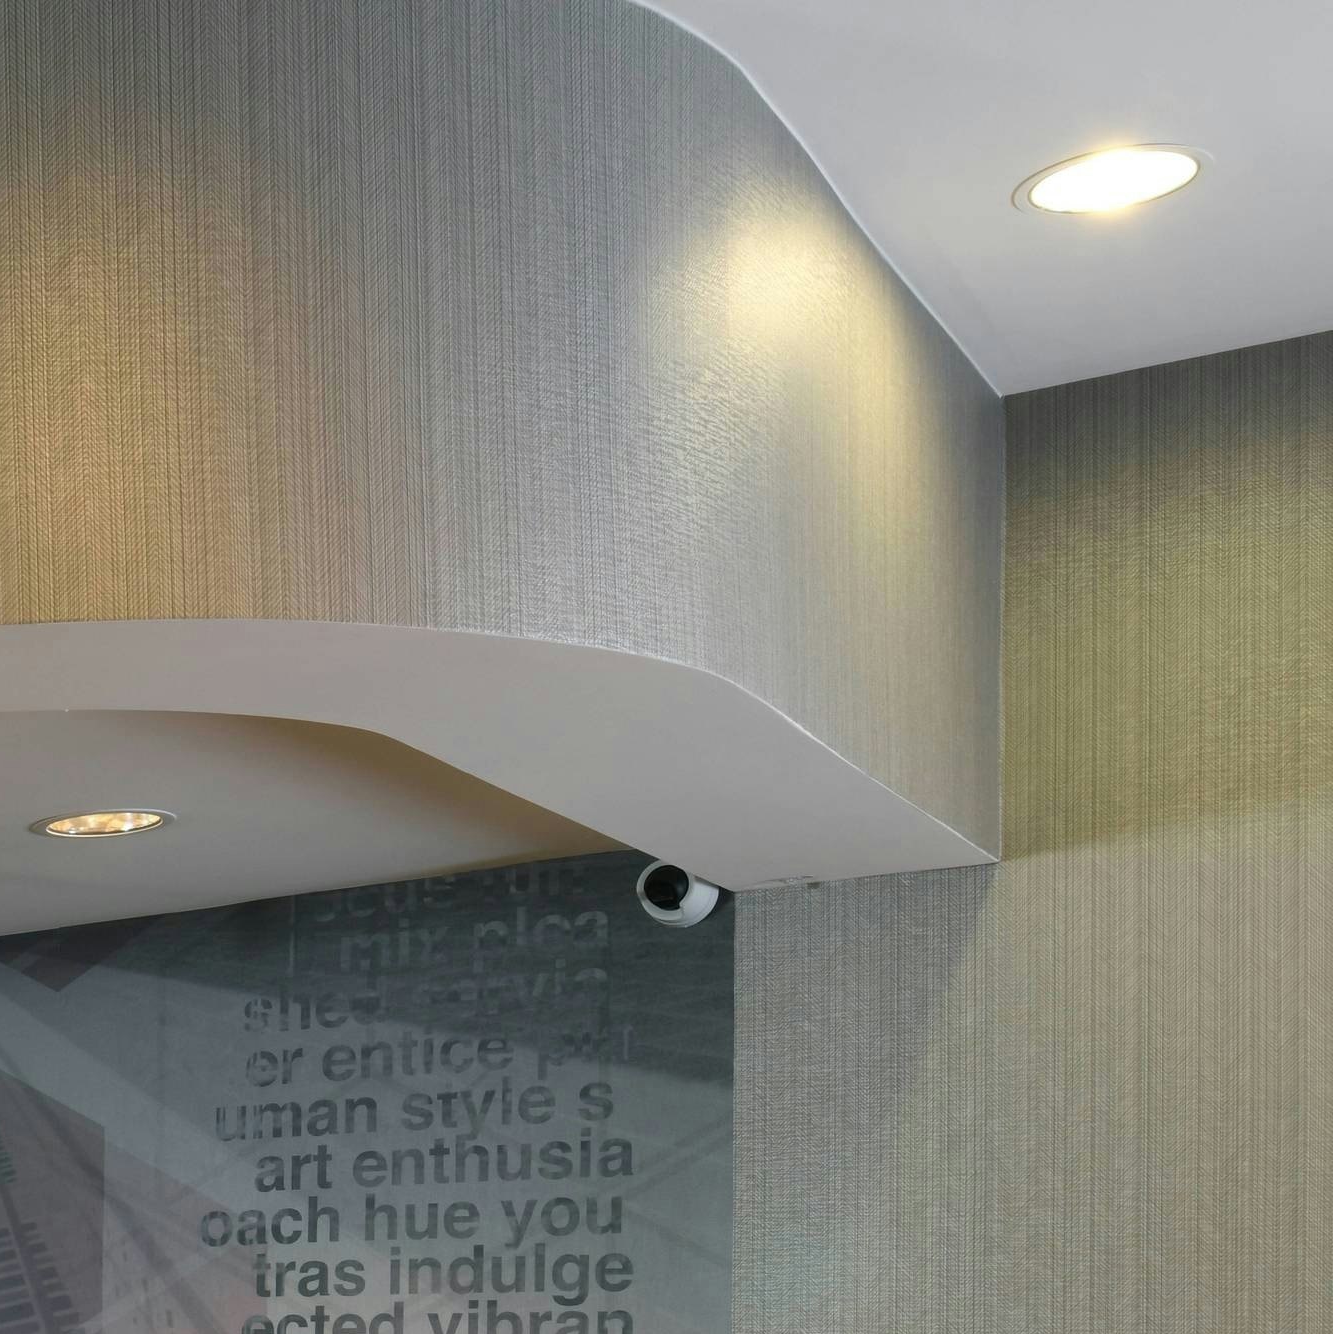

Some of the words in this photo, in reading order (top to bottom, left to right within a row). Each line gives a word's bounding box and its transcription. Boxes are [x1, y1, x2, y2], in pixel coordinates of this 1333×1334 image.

[244, 1046, 303, 1087] er
[321, 1029, 514, 1083] entice
[215, 1094, 378, 1142] uman
[400, 1074, 557, 1141] style
[576, 1080, 615, 1123] s
[254, 1144, 333, 1193] art
[352, 1128, 634, 1188] enthusia
[200, 1195, 340, 1247] oach
[363, 1193, 481, 1241] hue
[503, 1194, 623, 1249] you
[252, 1253, 366, 1298] tras
[389, 1243, 633, 1306] indulge
